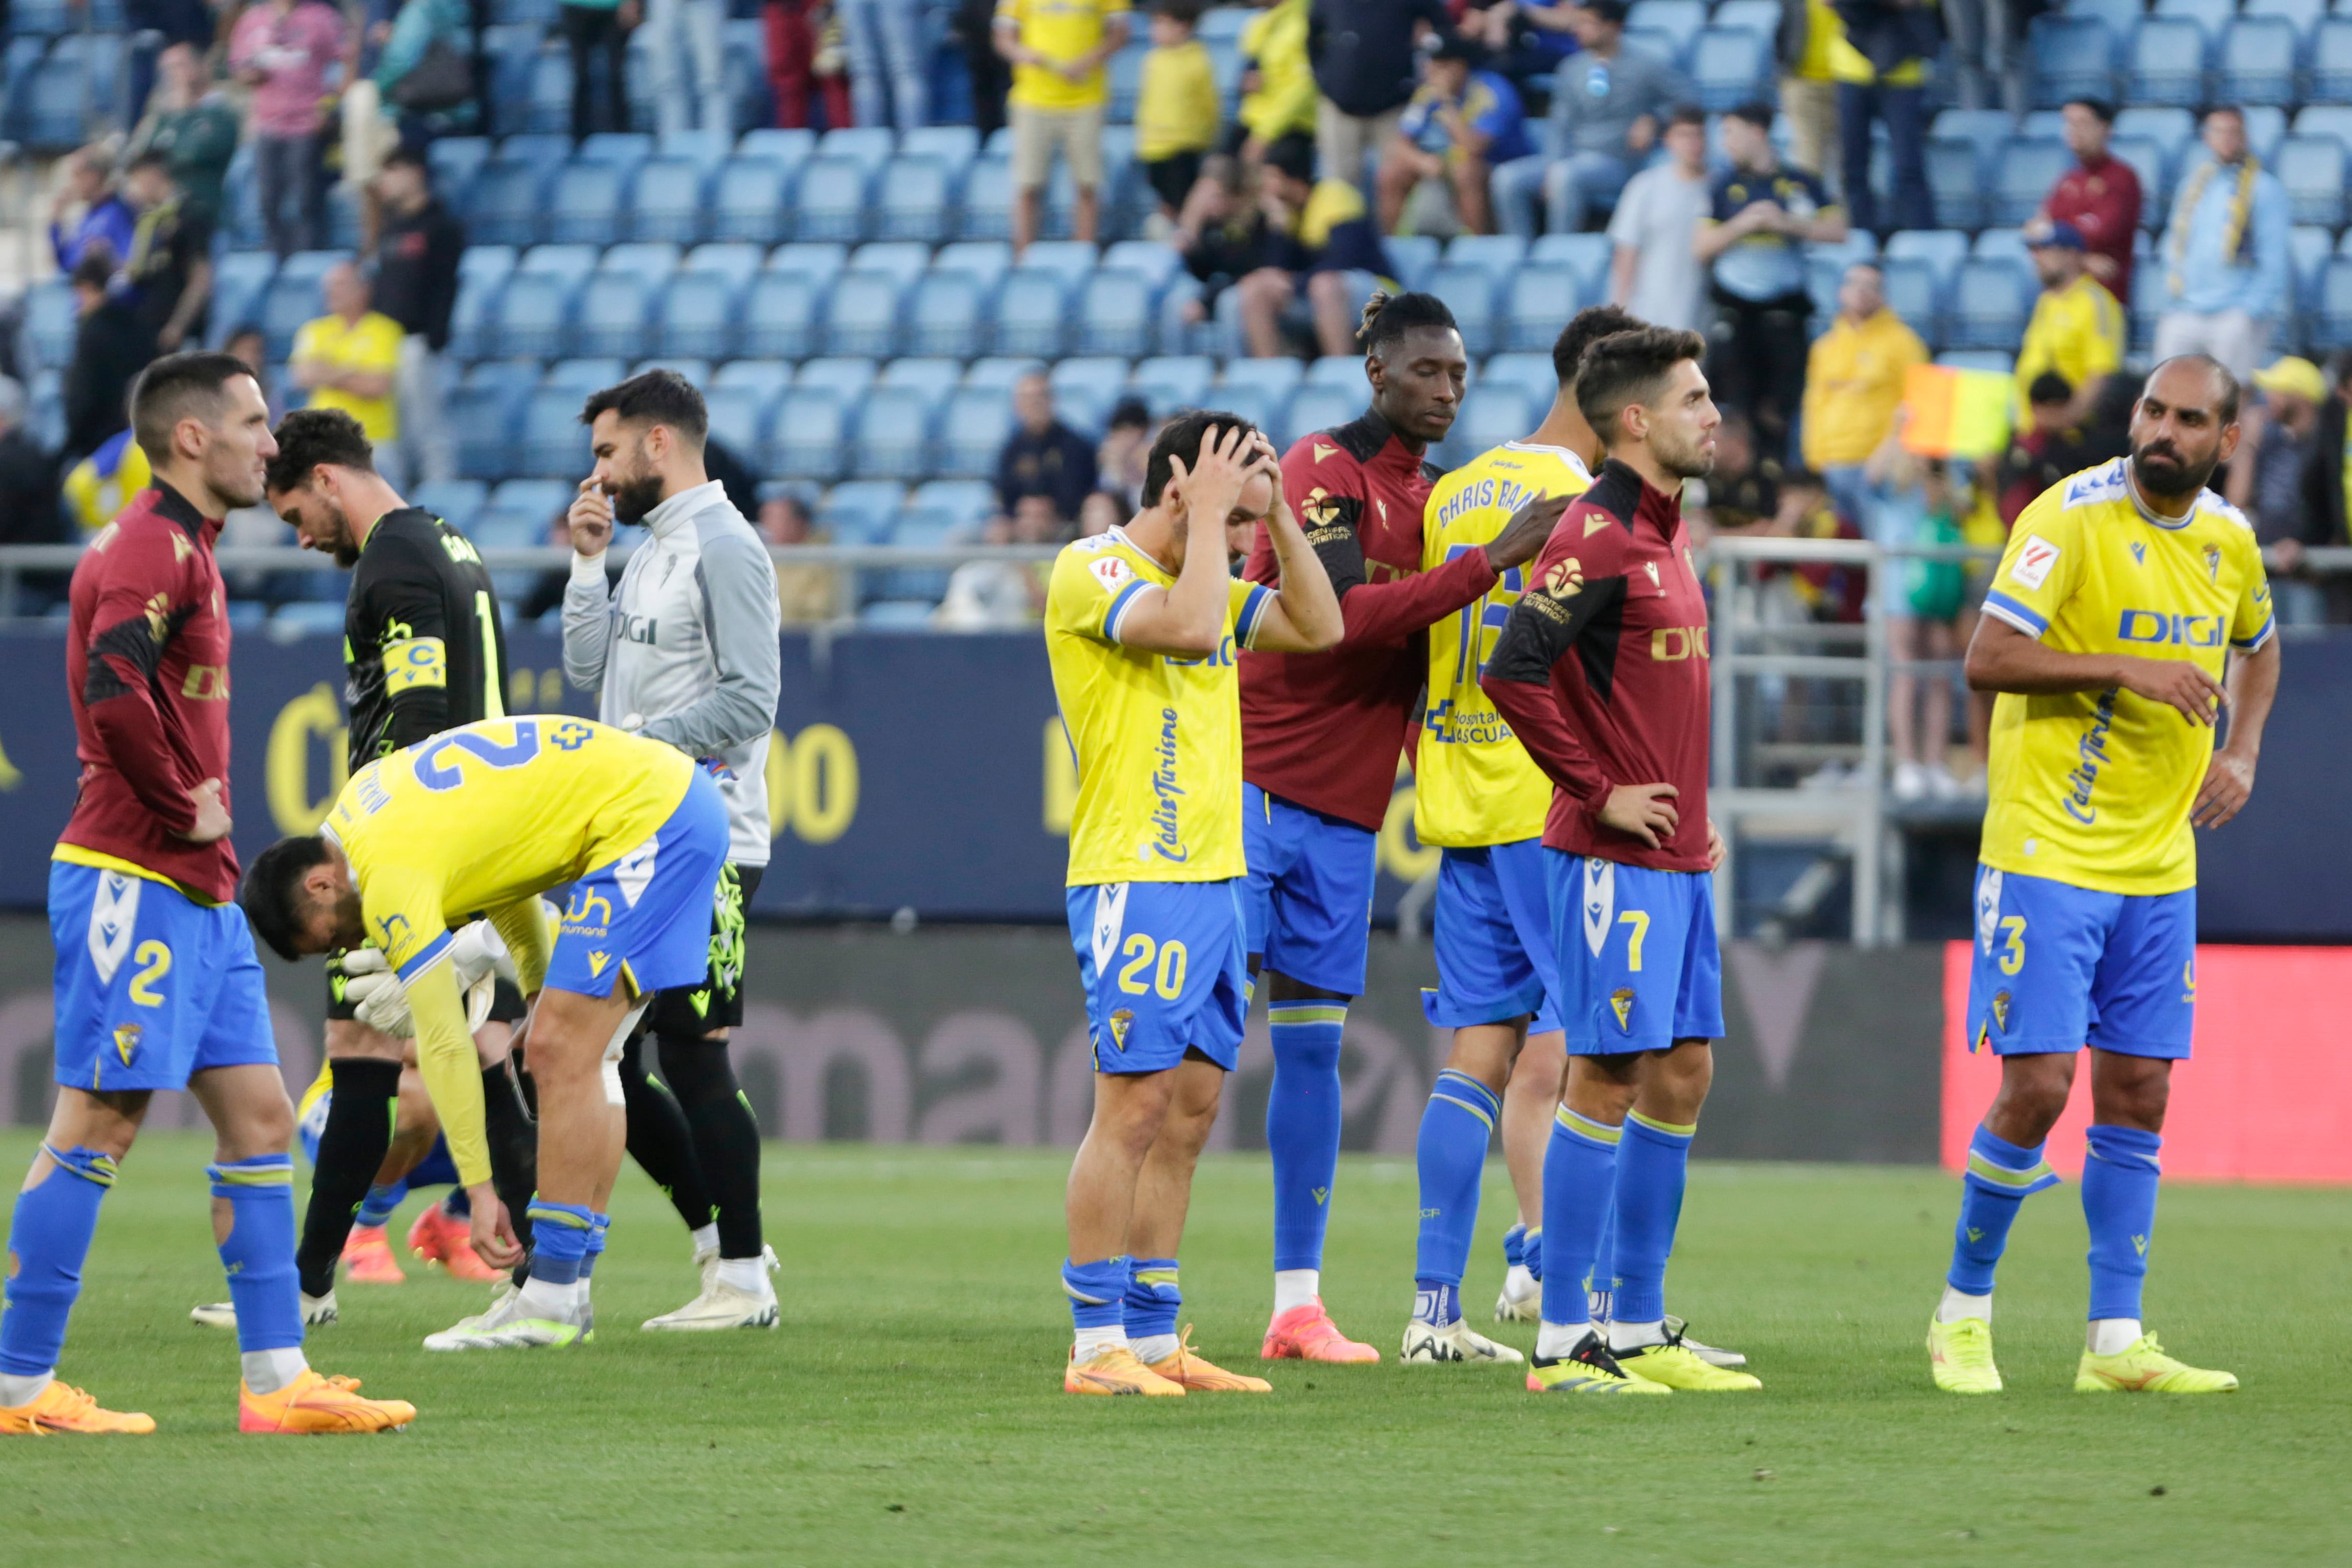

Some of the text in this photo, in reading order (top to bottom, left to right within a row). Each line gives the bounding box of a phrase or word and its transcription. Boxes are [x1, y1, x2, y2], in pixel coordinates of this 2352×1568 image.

[1439, 479, 1495, 528] CHRIS
[1304, 526, 1351, 538] CIENTIFFIC
[1310, 533, 1352, 546] UTRITION
[408, 645, 435, 665] C
[475, 590, 505, 720] 1
[2118, 608, 2225, 647] DIGI
[1118, 933, 1187, 1000] 20
[1618, 910, 1651, 972] 7
[1999, 915, 2027, 976] 3
[129, 939, 173, 1008] 2
